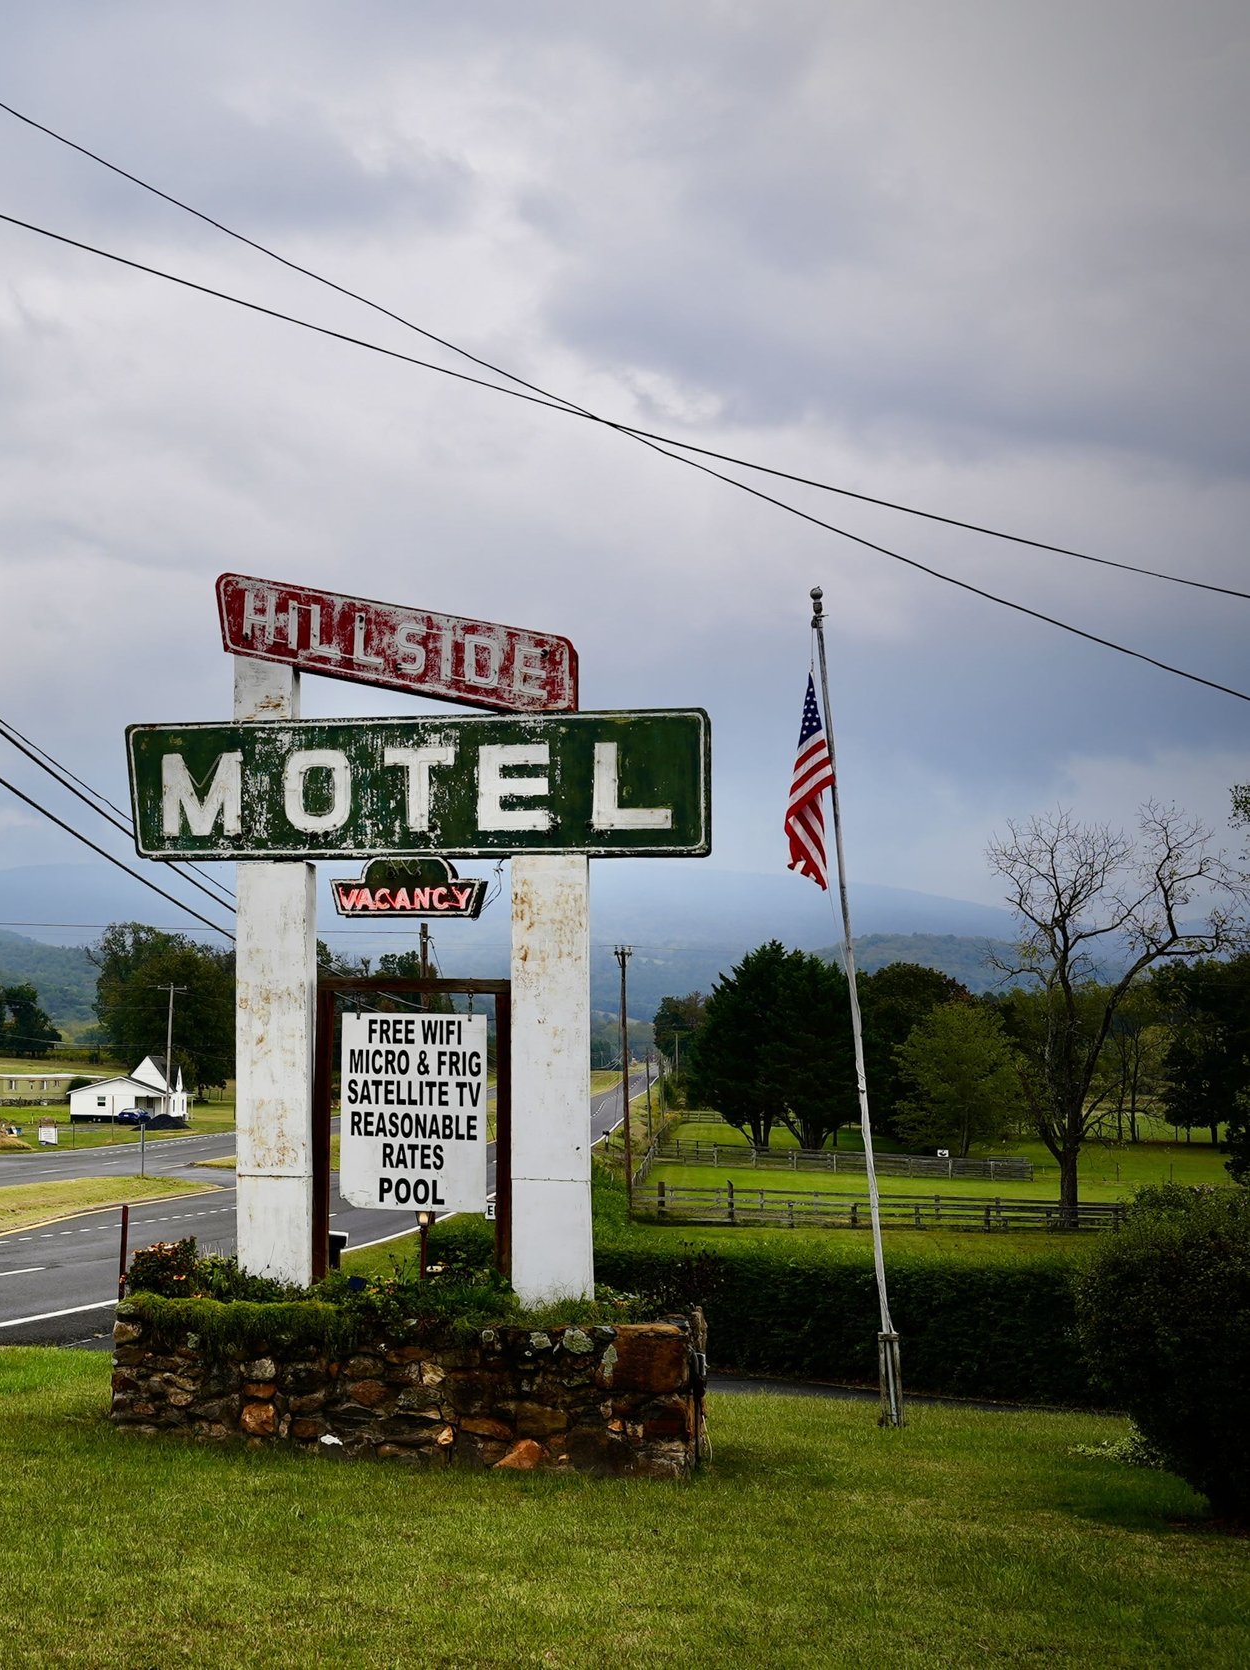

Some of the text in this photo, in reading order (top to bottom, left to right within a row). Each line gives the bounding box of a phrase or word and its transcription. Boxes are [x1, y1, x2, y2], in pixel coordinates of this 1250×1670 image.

[242, 589, 548, 698] HILLSIDE
[161, 741, 673, 837] MOTEL
[338, 886, 473, 910] VACANCY
[367, 1019, 462, 1046] FREE WIFI
[349, 1049, 482, 1077] MICRO & FRIG
[347, 1079, 482, 1107] SATELLITE TV
[350, 1111, 478, 1141] REASONABLE
[382, 1143, 444, 1170] RATES
[378, 1177, 445, 1205] POOL
